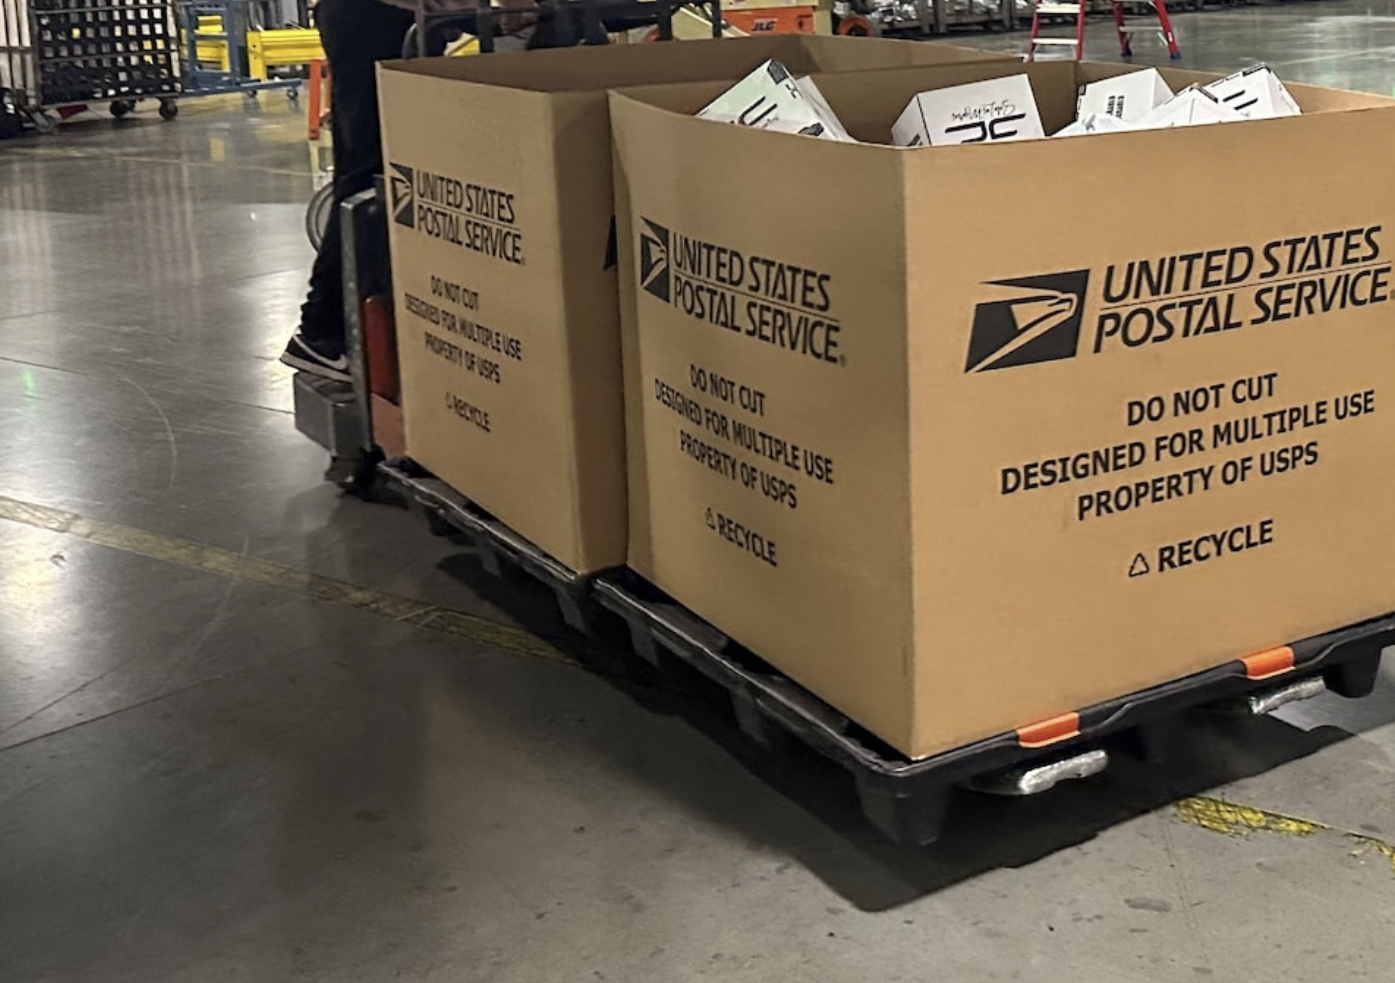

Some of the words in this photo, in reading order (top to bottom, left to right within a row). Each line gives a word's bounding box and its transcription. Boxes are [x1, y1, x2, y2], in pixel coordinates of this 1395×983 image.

[752, 19, 776, 32] JLG
[417, 169, 463, 208] UNITED
[465, 183, 515, 224] STATES
[417, 204, 463, 245] POSTAL
[465, 219, 522, 264] SERVICE
[1102, 245, 1254, 303] UNITED
[1259, 225, 1381, 278] STATES
[431, 275, 442, 297] DO
[444, 281, 460, 304] NOT
[462, 287, 479, 311] CUT
[673, 232, 744, 288] UNITED
[749, 256, 830, 313] STATES
[405, 292, 440, 325] DESIGNED
[441, 309, 458, 333] FOR
[459, 318, 501, 352] MULTIPLE
[502, 333, 522, 361] USE
[674, 274, 741, 333] POSTAL
[746, 301, 840, 364] SERVICE
[1093, 296, 1242, 353] POSTAL
[1251, 266, 1391, 325] SERVICE
[424, 331, 462, 366] PROPERTY
[464, 350, 476, 372] OF
[477, 355, 500, 384] USPS
[453, 395, 491, 432] RECYCLE
[690, 364, 706, 392] DO
[710, 373, 735, 404] NOT
[739, 385, 765, 416] CUT
[1127, 397, 1164, 426] DO
[1173, 383, 1225, 417] NOT
[1232, 373, 1278, 404] CUT
[655, 378, 701, 426] DESIGNED
[705, 408, 729, 441] FOR
[733, 420, 799, 470] MULTIPLE
[804, 450, 834, 484] USE
[1001, 442, 1145, 494] DESIGNED
[1155, 429, 1205, 460] FOR
[1212, 401, 1327, 449] MULTIPLE
[1334, 390, 1375, 420] USE
[680, 430, 736, 480] PROPERTY
[740, 461, 757, 488] OF
[761, 468, 796, 509] USPS
[1078, 466, 1214, 520] PROPERTY
[1221, 457, 1252, 484] OF
[1260, 442, 1319, 476] USPS
[718, 513, 777, 566] RECYCLE
[1158, 519, 1273, 572] RECYCLE
